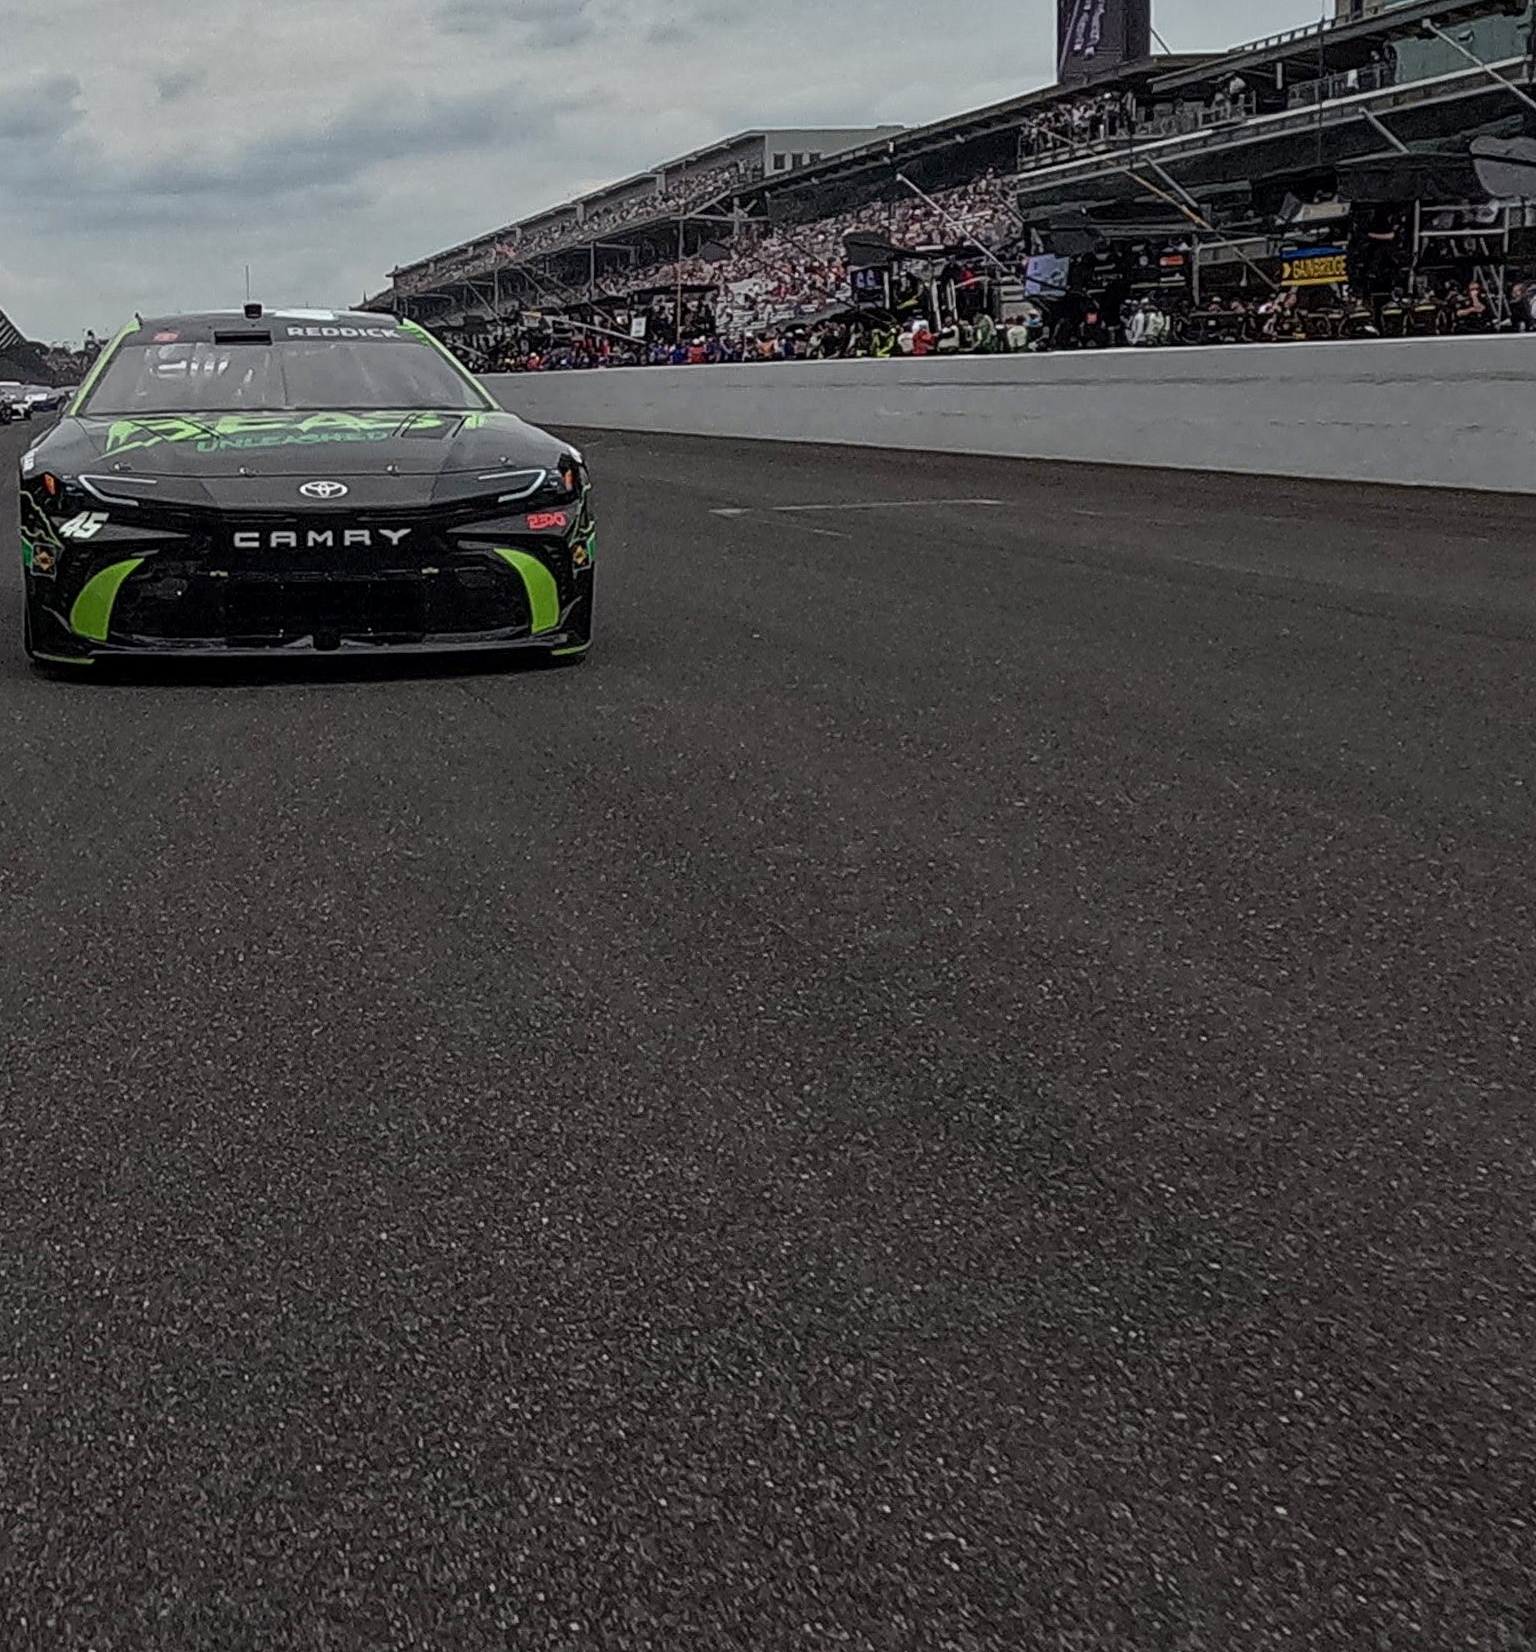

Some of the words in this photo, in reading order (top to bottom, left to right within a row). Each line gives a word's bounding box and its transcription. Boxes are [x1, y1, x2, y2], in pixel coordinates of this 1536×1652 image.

[286, 325, 402, 340] REDDICK
[59, 511, 109, 539] 45
[233, 528, 412, 549] CAMRY
